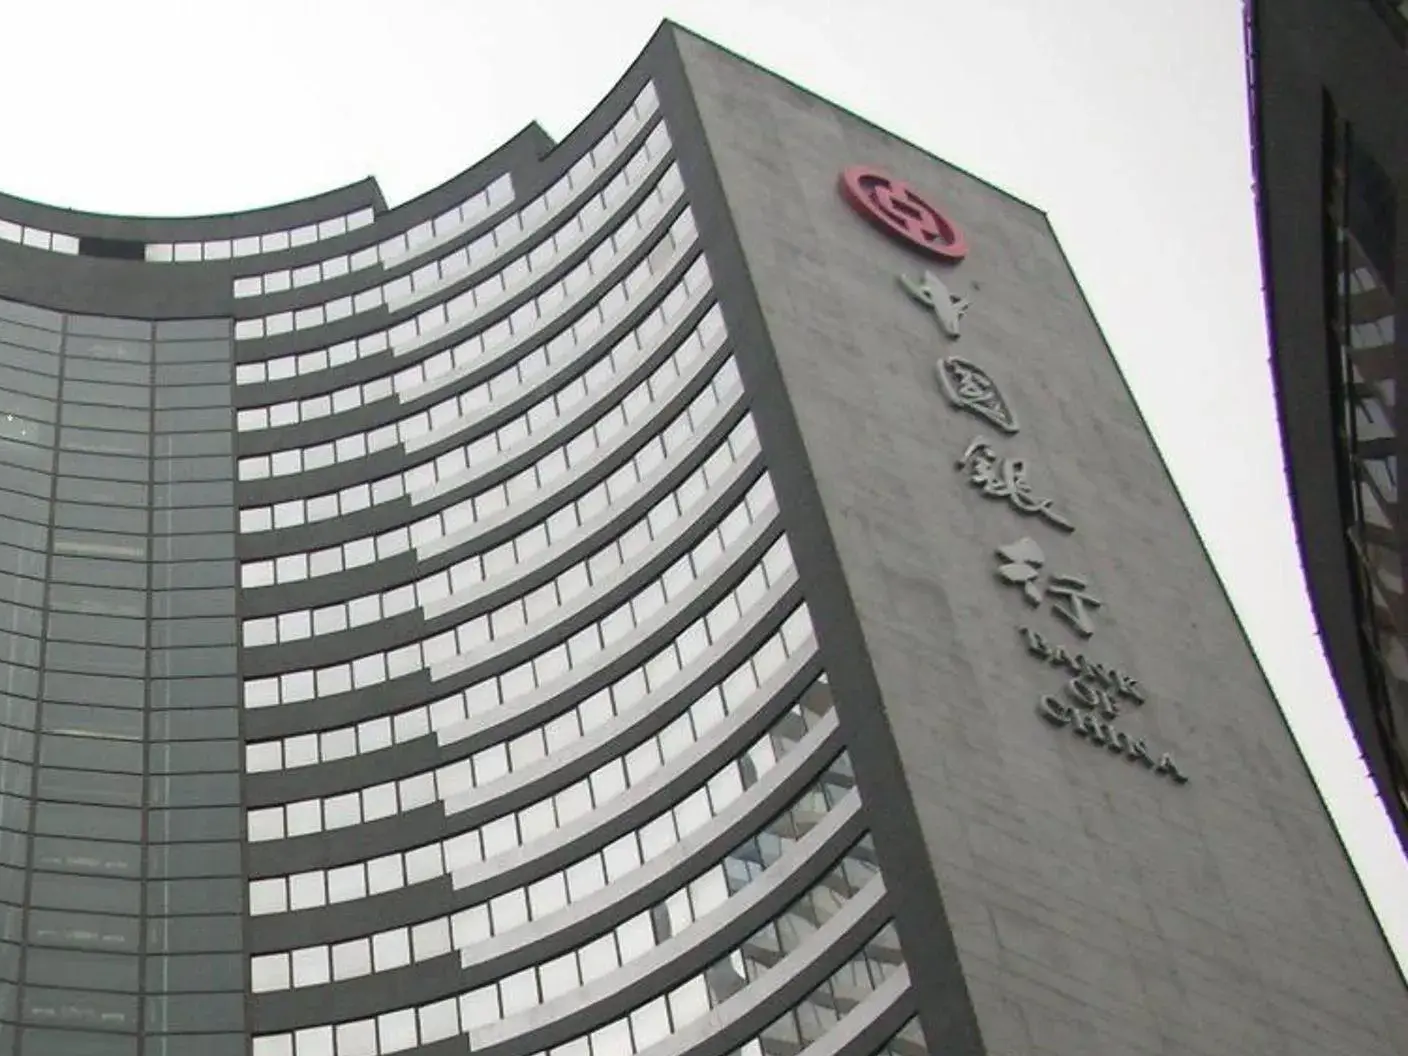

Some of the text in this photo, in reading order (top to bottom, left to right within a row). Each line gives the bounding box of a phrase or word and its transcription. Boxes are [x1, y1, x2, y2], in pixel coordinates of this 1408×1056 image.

[1019, 625, 1145, 705] BANK
[1065, 677, 1118, 720] OF
[1039, 693, 1188, 784] CHINA
